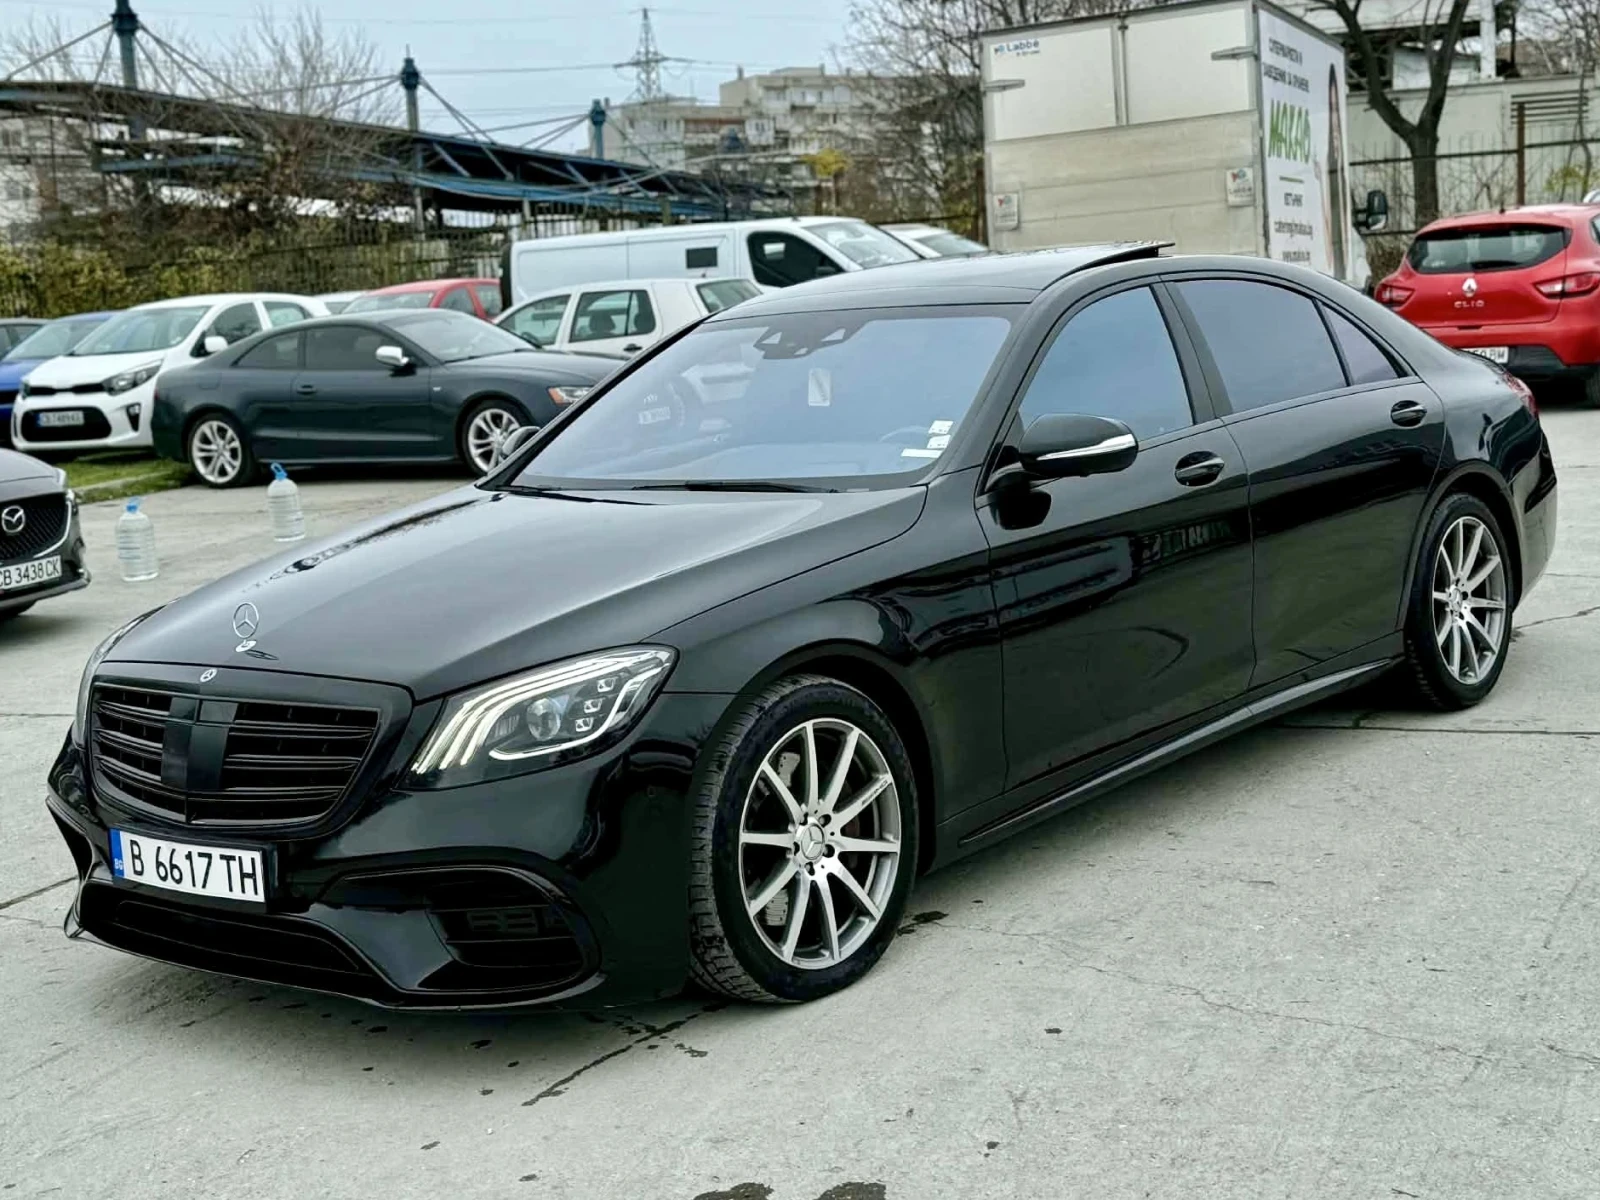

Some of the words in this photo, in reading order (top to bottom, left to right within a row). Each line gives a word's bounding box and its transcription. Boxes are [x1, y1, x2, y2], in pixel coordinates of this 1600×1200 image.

[1454, 300, 1485, 309] CLIO
[14, 562, 44, 584] 3438
[46, 558, 60, 577] CK
[114, 858, 123, 870] BG
[130, 839, 145, 876] B
[155, 846, 213, 889] 6617
[219, 854, 259, 896] TH
